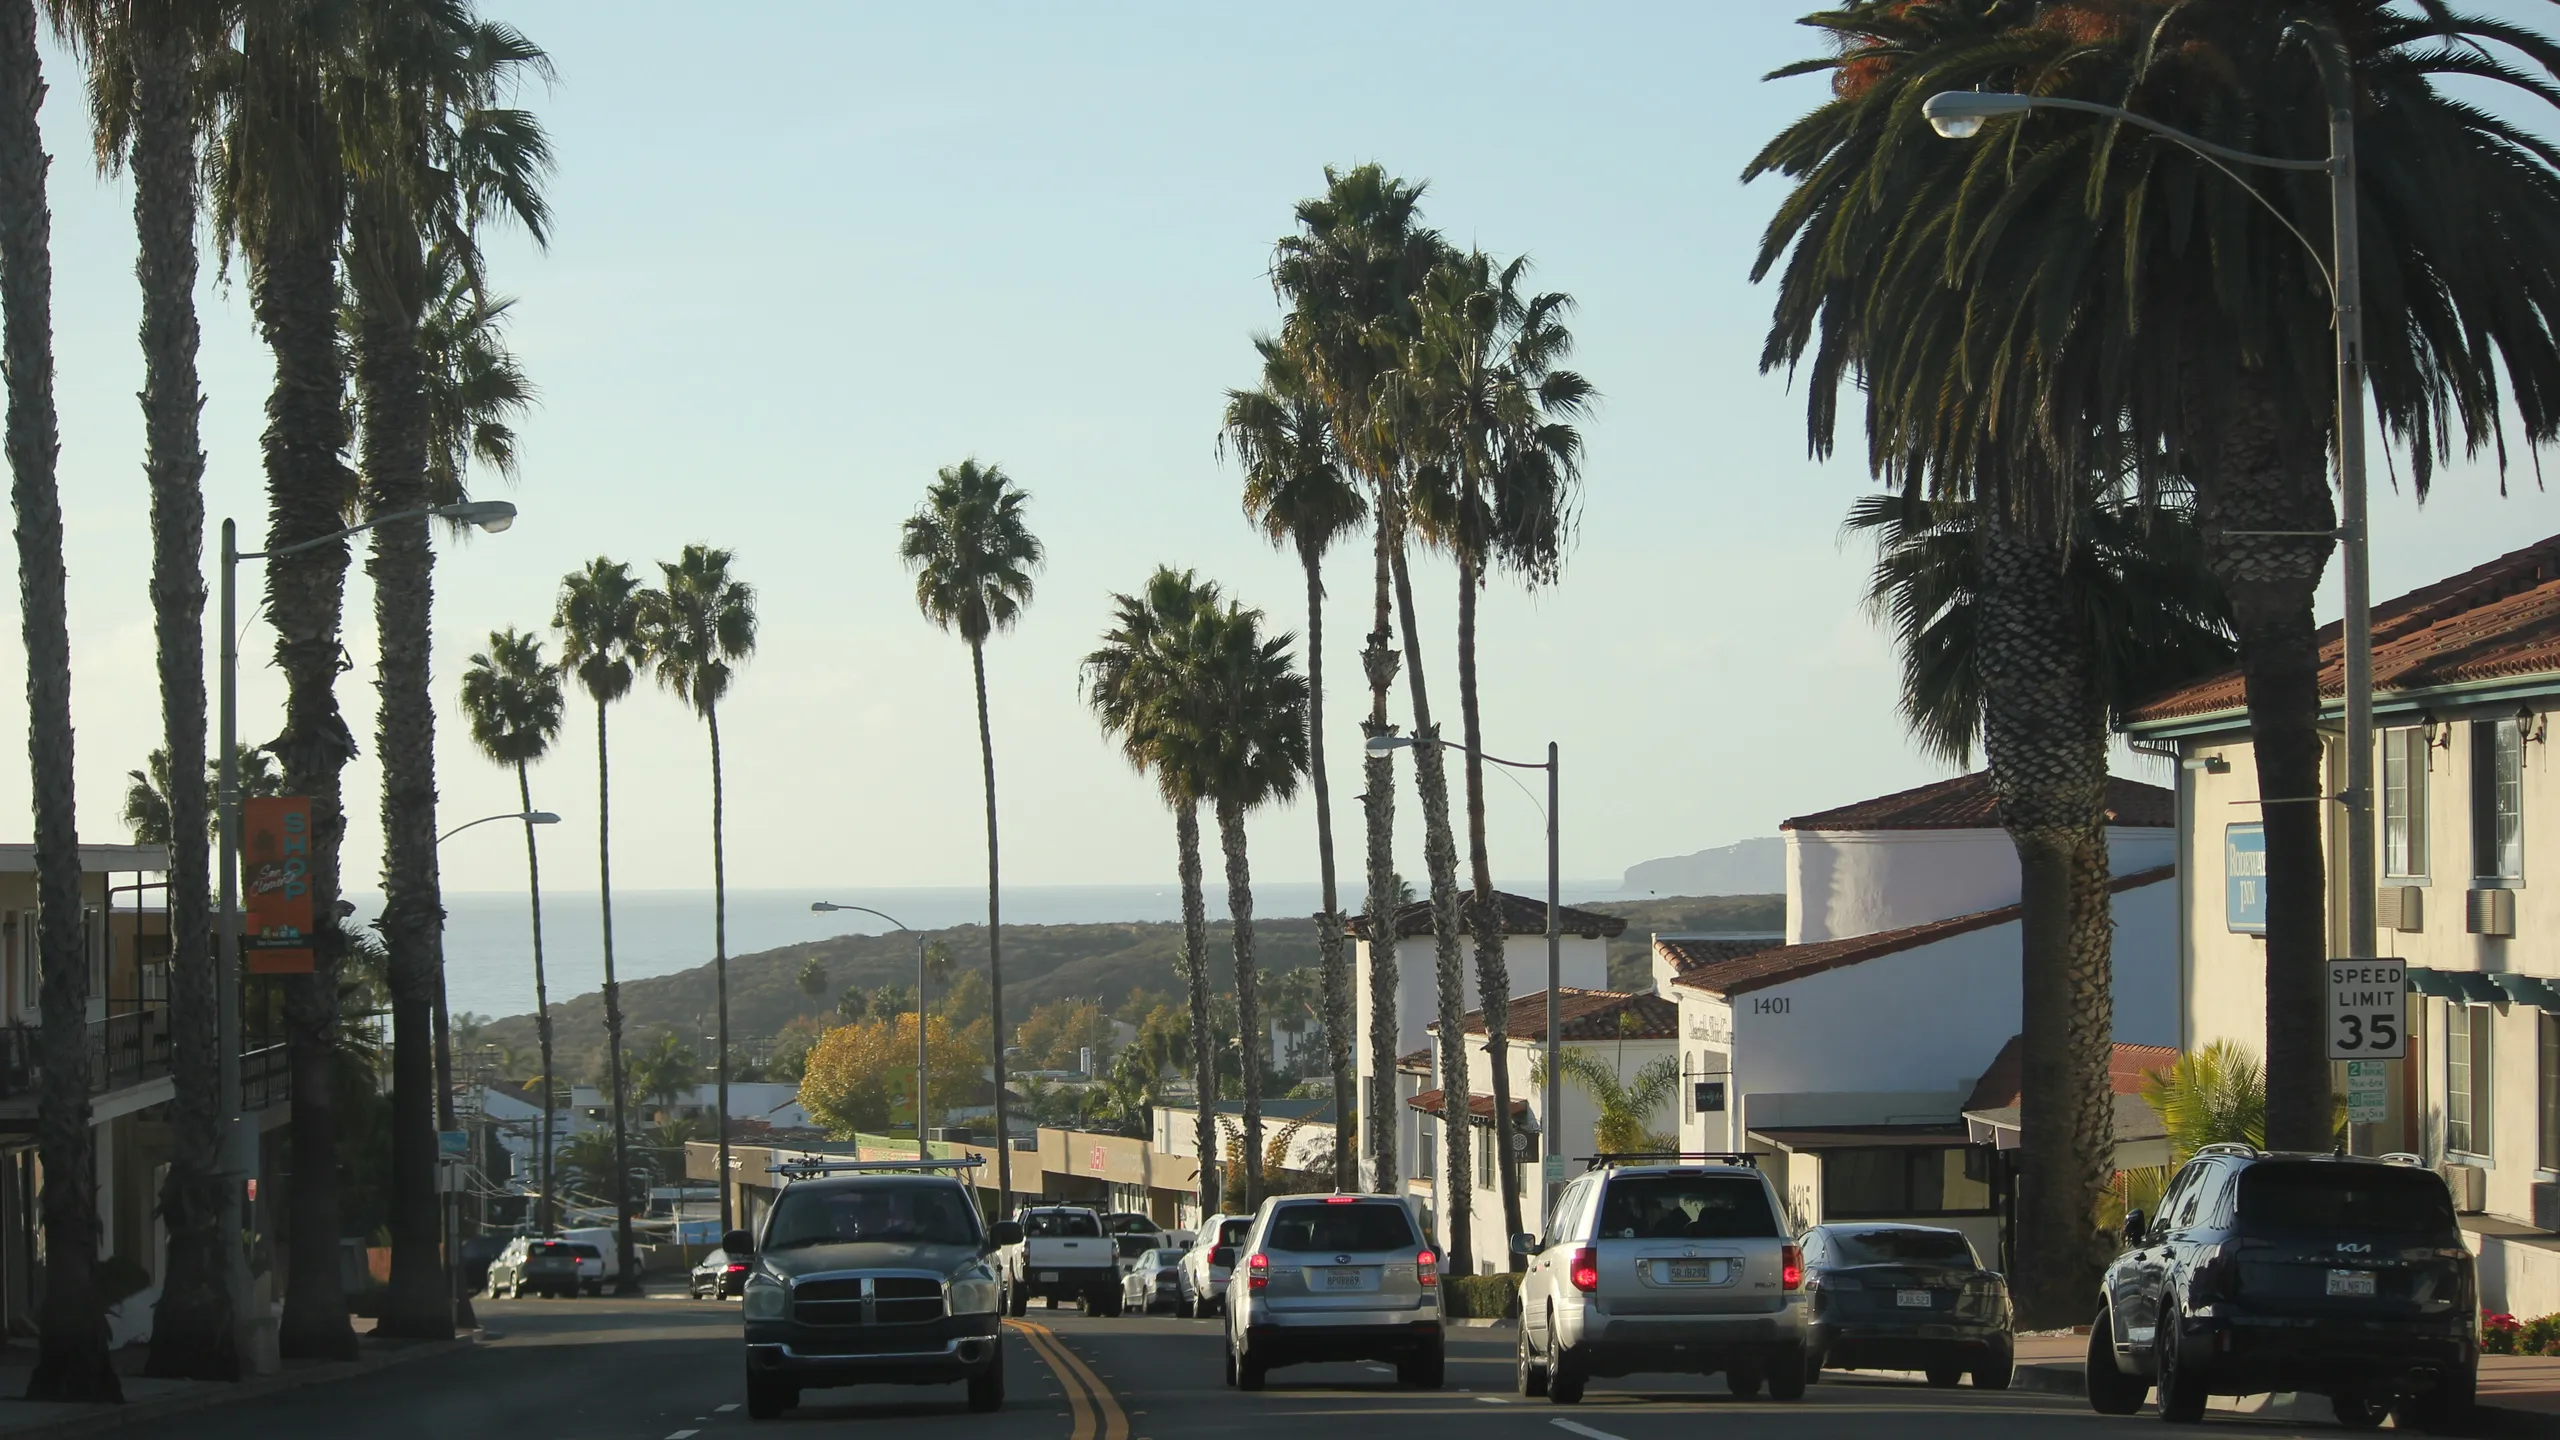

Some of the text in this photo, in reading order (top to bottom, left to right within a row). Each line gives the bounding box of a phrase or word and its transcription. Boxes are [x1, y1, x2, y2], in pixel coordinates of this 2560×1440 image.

[284, 812, 306, 902] SHOP
[260, 864, 281, 880] San
[2240, 881, 2256, 913] INN
[2333, 968, 2401, 984] SPEED
[1754, 997, 1790, 1014] 1401
[2339, 991, 2395, 1007] LIMIT
[2336, 1014, 2397, 1051] 35
[2350, 1063, 2358, 1075] 2
